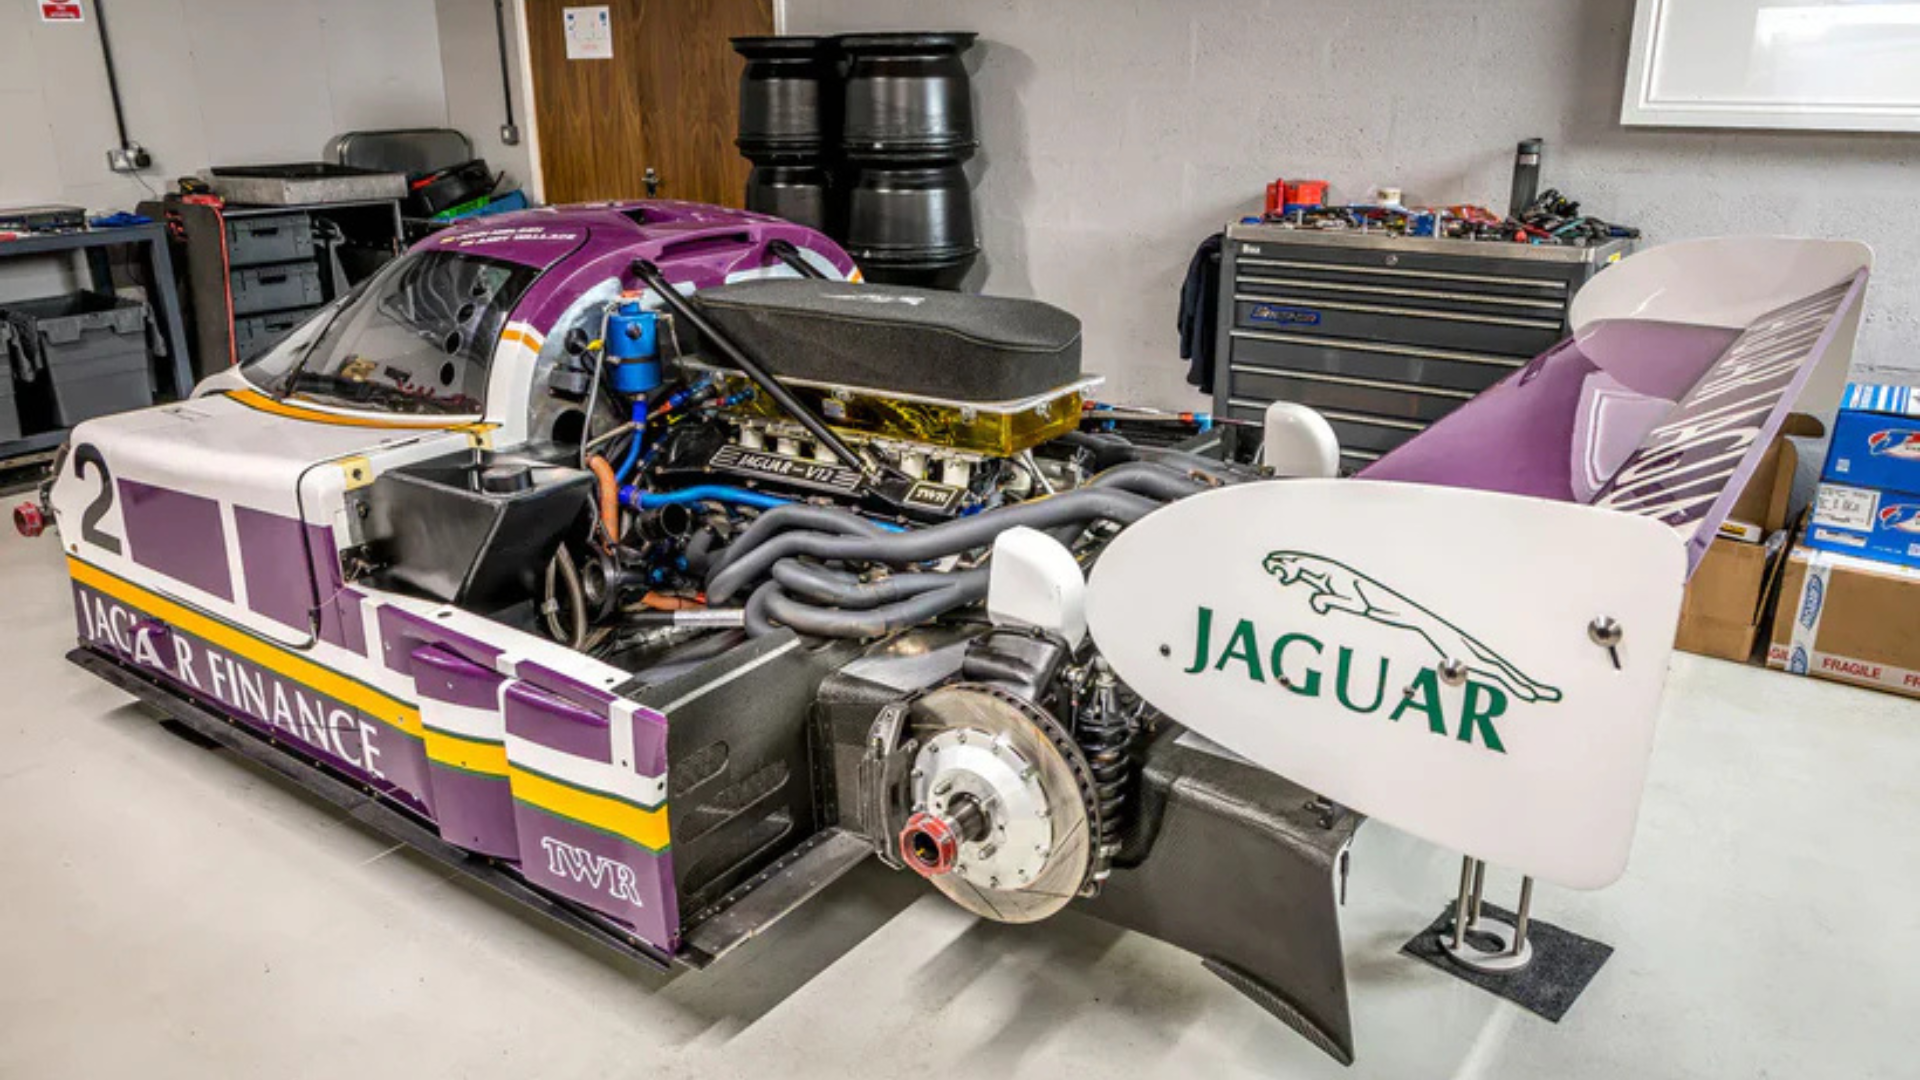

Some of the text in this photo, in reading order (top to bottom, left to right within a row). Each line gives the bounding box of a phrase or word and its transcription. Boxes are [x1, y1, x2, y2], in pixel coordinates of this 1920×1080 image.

[74, 442, 122, 556] 2
[206, 648, 386, 780] FINANCE
[1184, 605, 1507, 755] JAGUAR
[1820, 657, 1882, 680] FRAGILE
[540, 835, 644, 907] TWR
